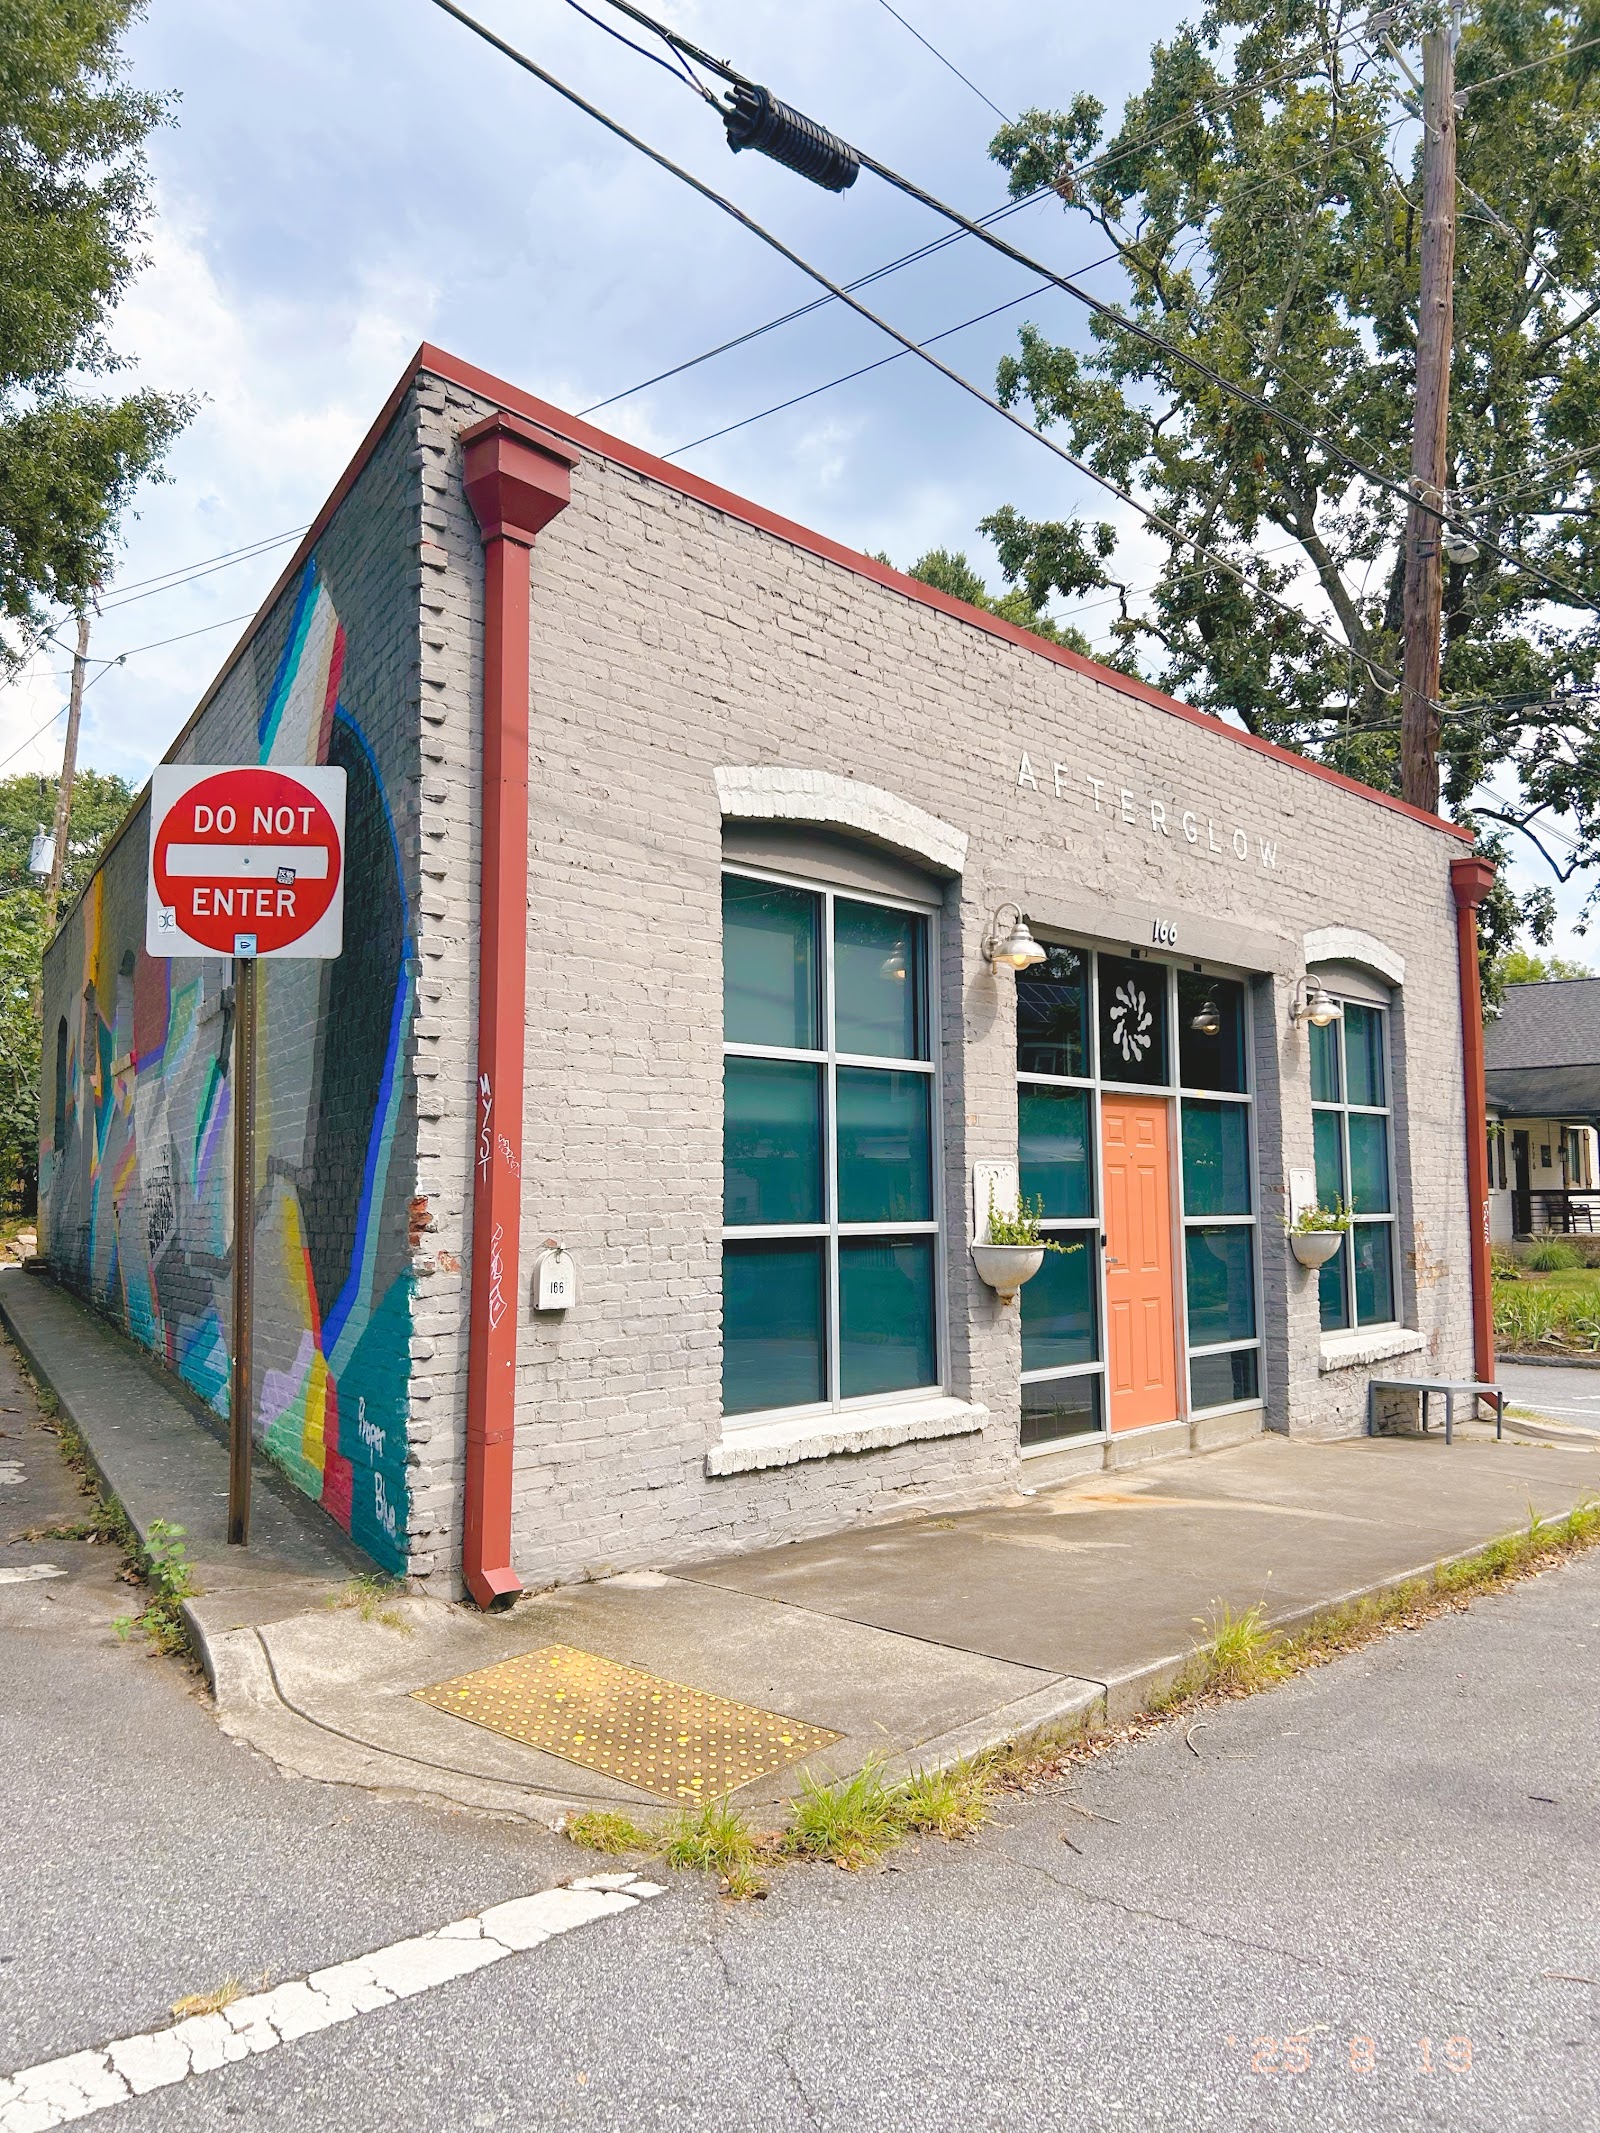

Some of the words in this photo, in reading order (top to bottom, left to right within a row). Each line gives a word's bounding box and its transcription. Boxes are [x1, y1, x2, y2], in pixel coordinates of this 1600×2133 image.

[194, 805, 236, 834] DO
[253, 807, 315, 835] NOT
[1017, 751, 1278, 869] AFTERGLOW
[193, 888, 296, 917] ENTER
[1153, 917, 1178, 946] 166
[550, 1281, 564, 1294] 166
